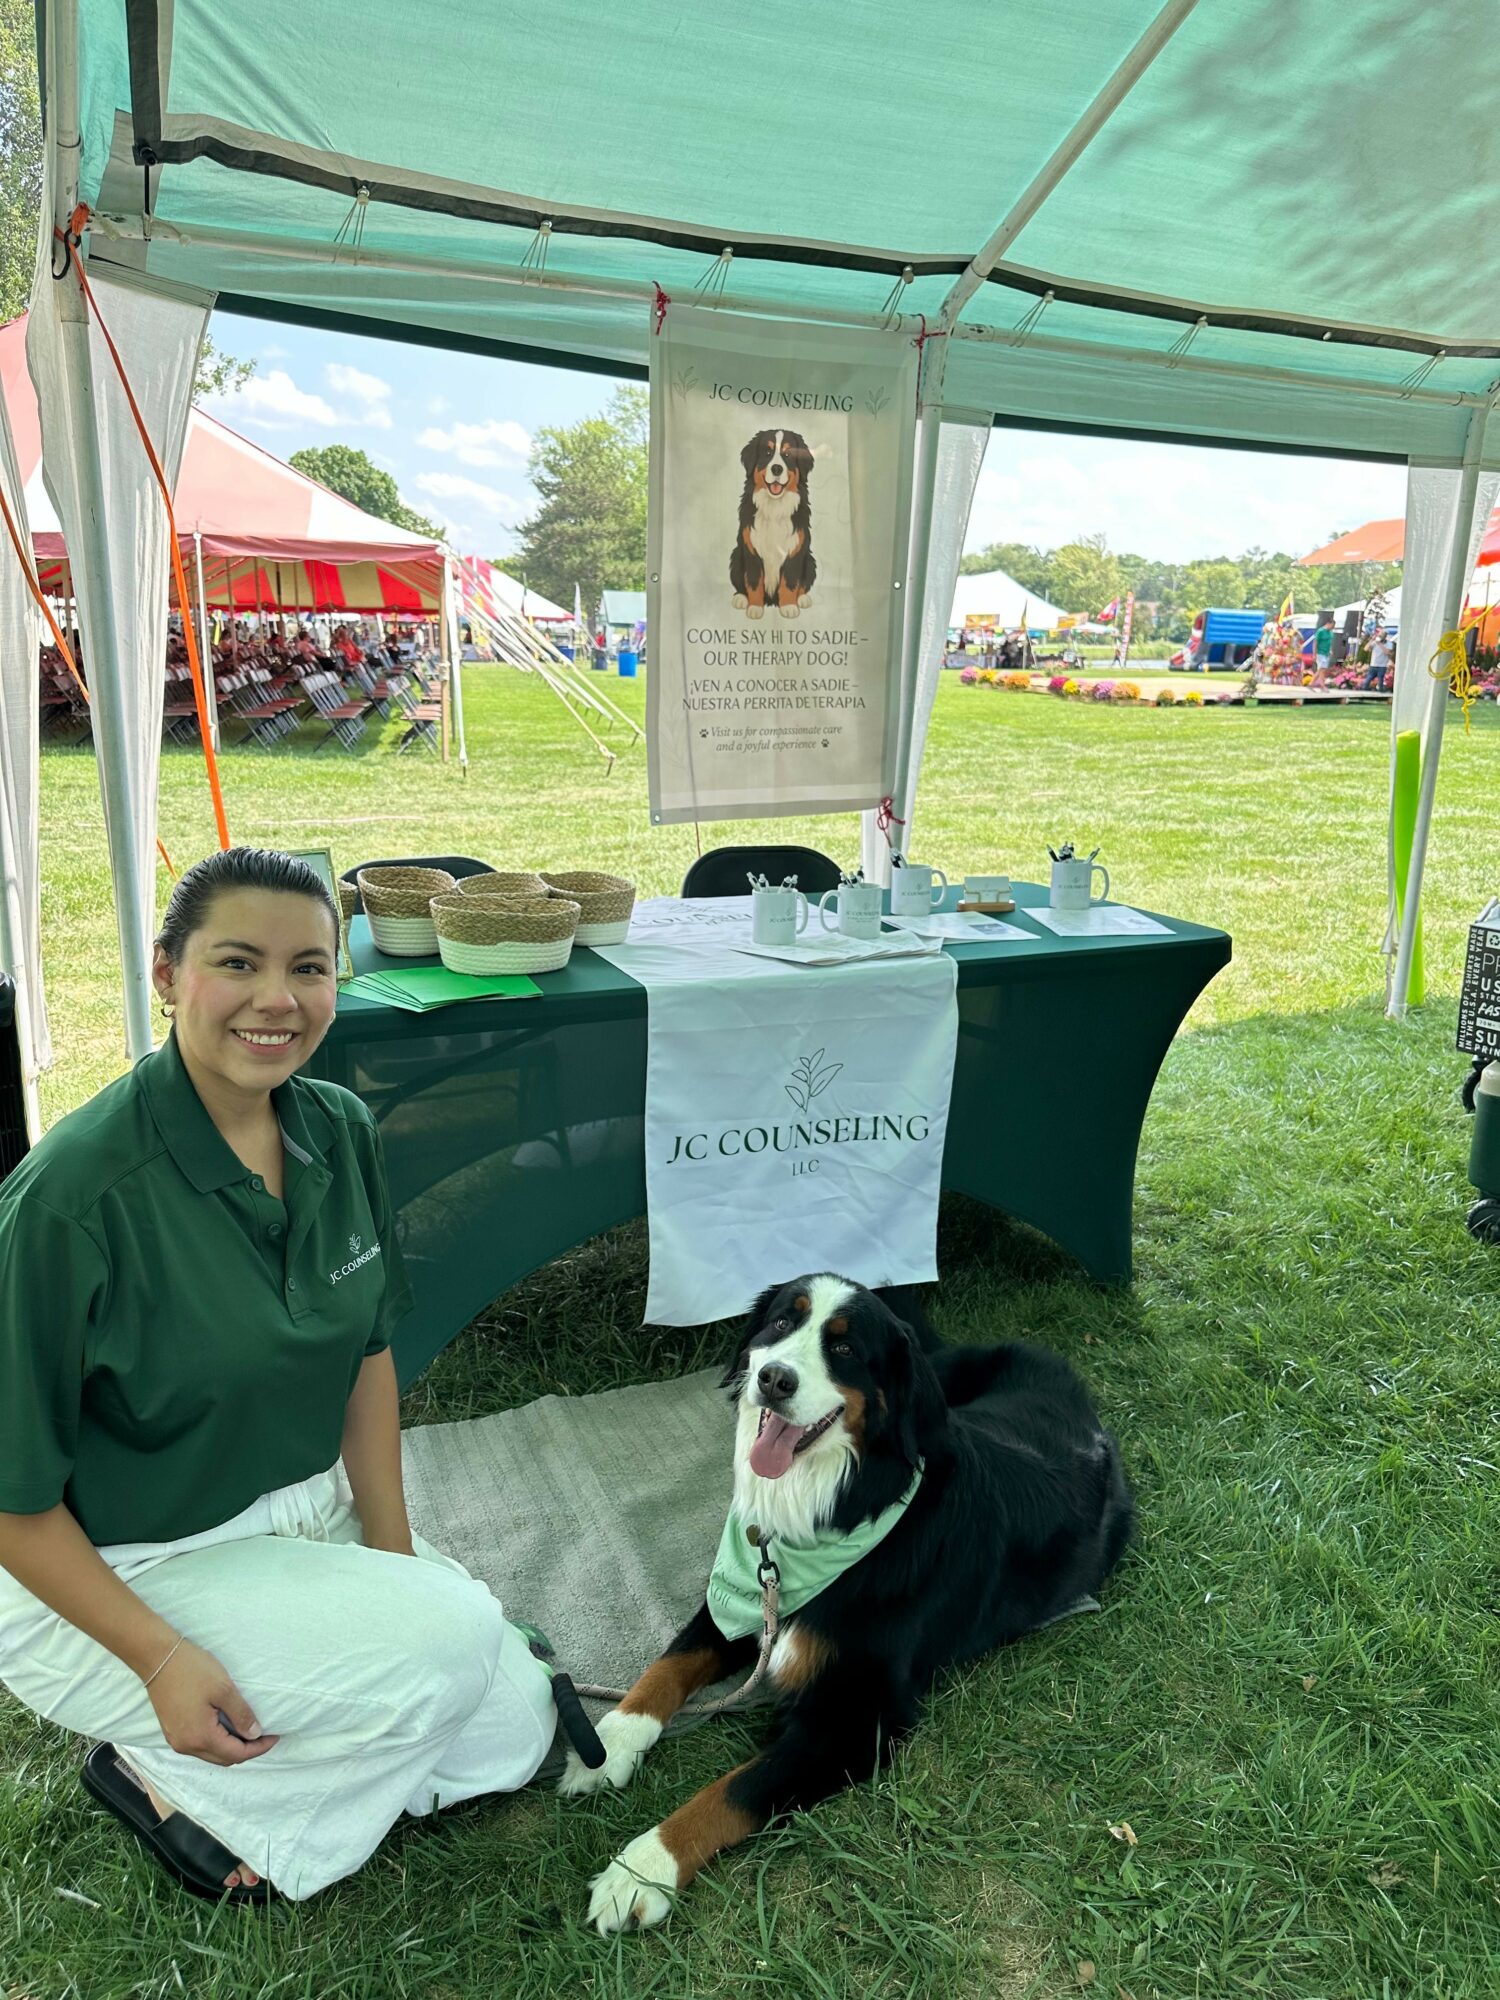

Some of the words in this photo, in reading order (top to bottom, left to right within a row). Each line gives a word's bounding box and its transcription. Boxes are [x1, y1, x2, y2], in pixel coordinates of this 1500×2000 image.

[709, 383, 732, 400] JC
[737, 387, 853, 412] COUNSELING
[687, 628, 736, 645] COME
[741, 629, 767, 645] SAY
[771, 630, 783, 645] HI
[787, 630, 807, 645] TO
[703, 651, 738, 666] OUR
[743, 651, 803, 666] THERAPY
[807, 651, 848, 666] DOG!
[724, 680, 734, 692] A
[736, 679, 798, 692] CONOCER
[800, 679, 809, 692] A
[682, 697, 740, 711] NUESTRA
[743, 696, 794, 710] PERRITA
[795, 696, 810, 709] DE
[812, 696, 867, 709] TERAPIA
[711, 726, 731, 737] Visit
[733, 729, 743, 737] us
[743, 726, 757, 739] for
[758, 726, 821, 739] compassionate
[822, 725, 843, 735] care
[716, 740, 735, 751] and
[736, 743, 742, 751] a
[742, 739, 770, 753] joyful
[772, 739, 817, 752] experience
[1469, 928, 1478, 952] MADE
[1475, 929, 1485, 953] YEAR
[1464, 954, 1475, 992] T-SHIRTS
[1471, 955, 1481, 985] EVERY
[1458, 1008, 1468, 1048] MILLIONS
[1465, 1019, 1474, 1037] THE
[666, 1134, 708, 1164] JC
[718, 1115, 929, 1156] COUNSELING
[792, 1159, 820, 1176] LLC
[329, 1270, 342, 1285] JC
[341, 1242, 381, 1275] COUNSELING
